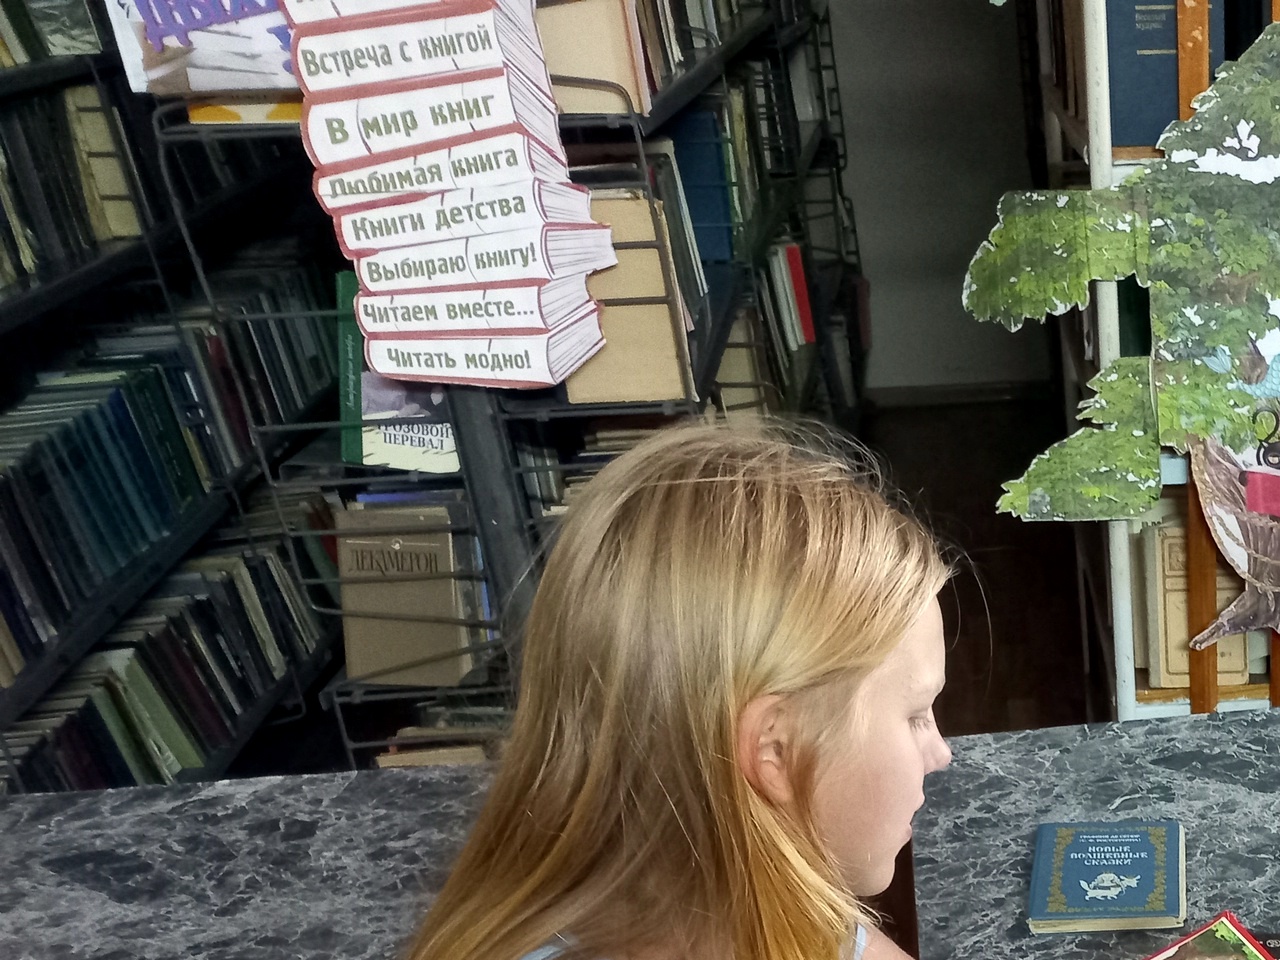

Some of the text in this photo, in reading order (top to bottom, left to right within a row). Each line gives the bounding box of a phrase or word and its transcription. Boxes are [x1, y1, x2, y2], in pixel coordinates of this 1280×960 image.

[302, 24, 493, 78] Встреча с книгой
[326, 94, 495, 145] В мир книг
[329, 145, 519, 198] Любимая книга
[350, 194, 527, 242] Книги детства
[366, 242, 537, 283] Выбираю книгу!
[363, 299, 535, 325] Читаем вместе...
[387, 347, 532, 372] Читать модно!
[383, 431, 445, 450] ПЕРЕВАЛ
[348, 549, 439, 576] ДЕКАМЕРОН
[1070, 852, 1149, 860] ВОЛШЕБНЫЕ
[1088, 845, 1131, 853] НОВЫЕ
